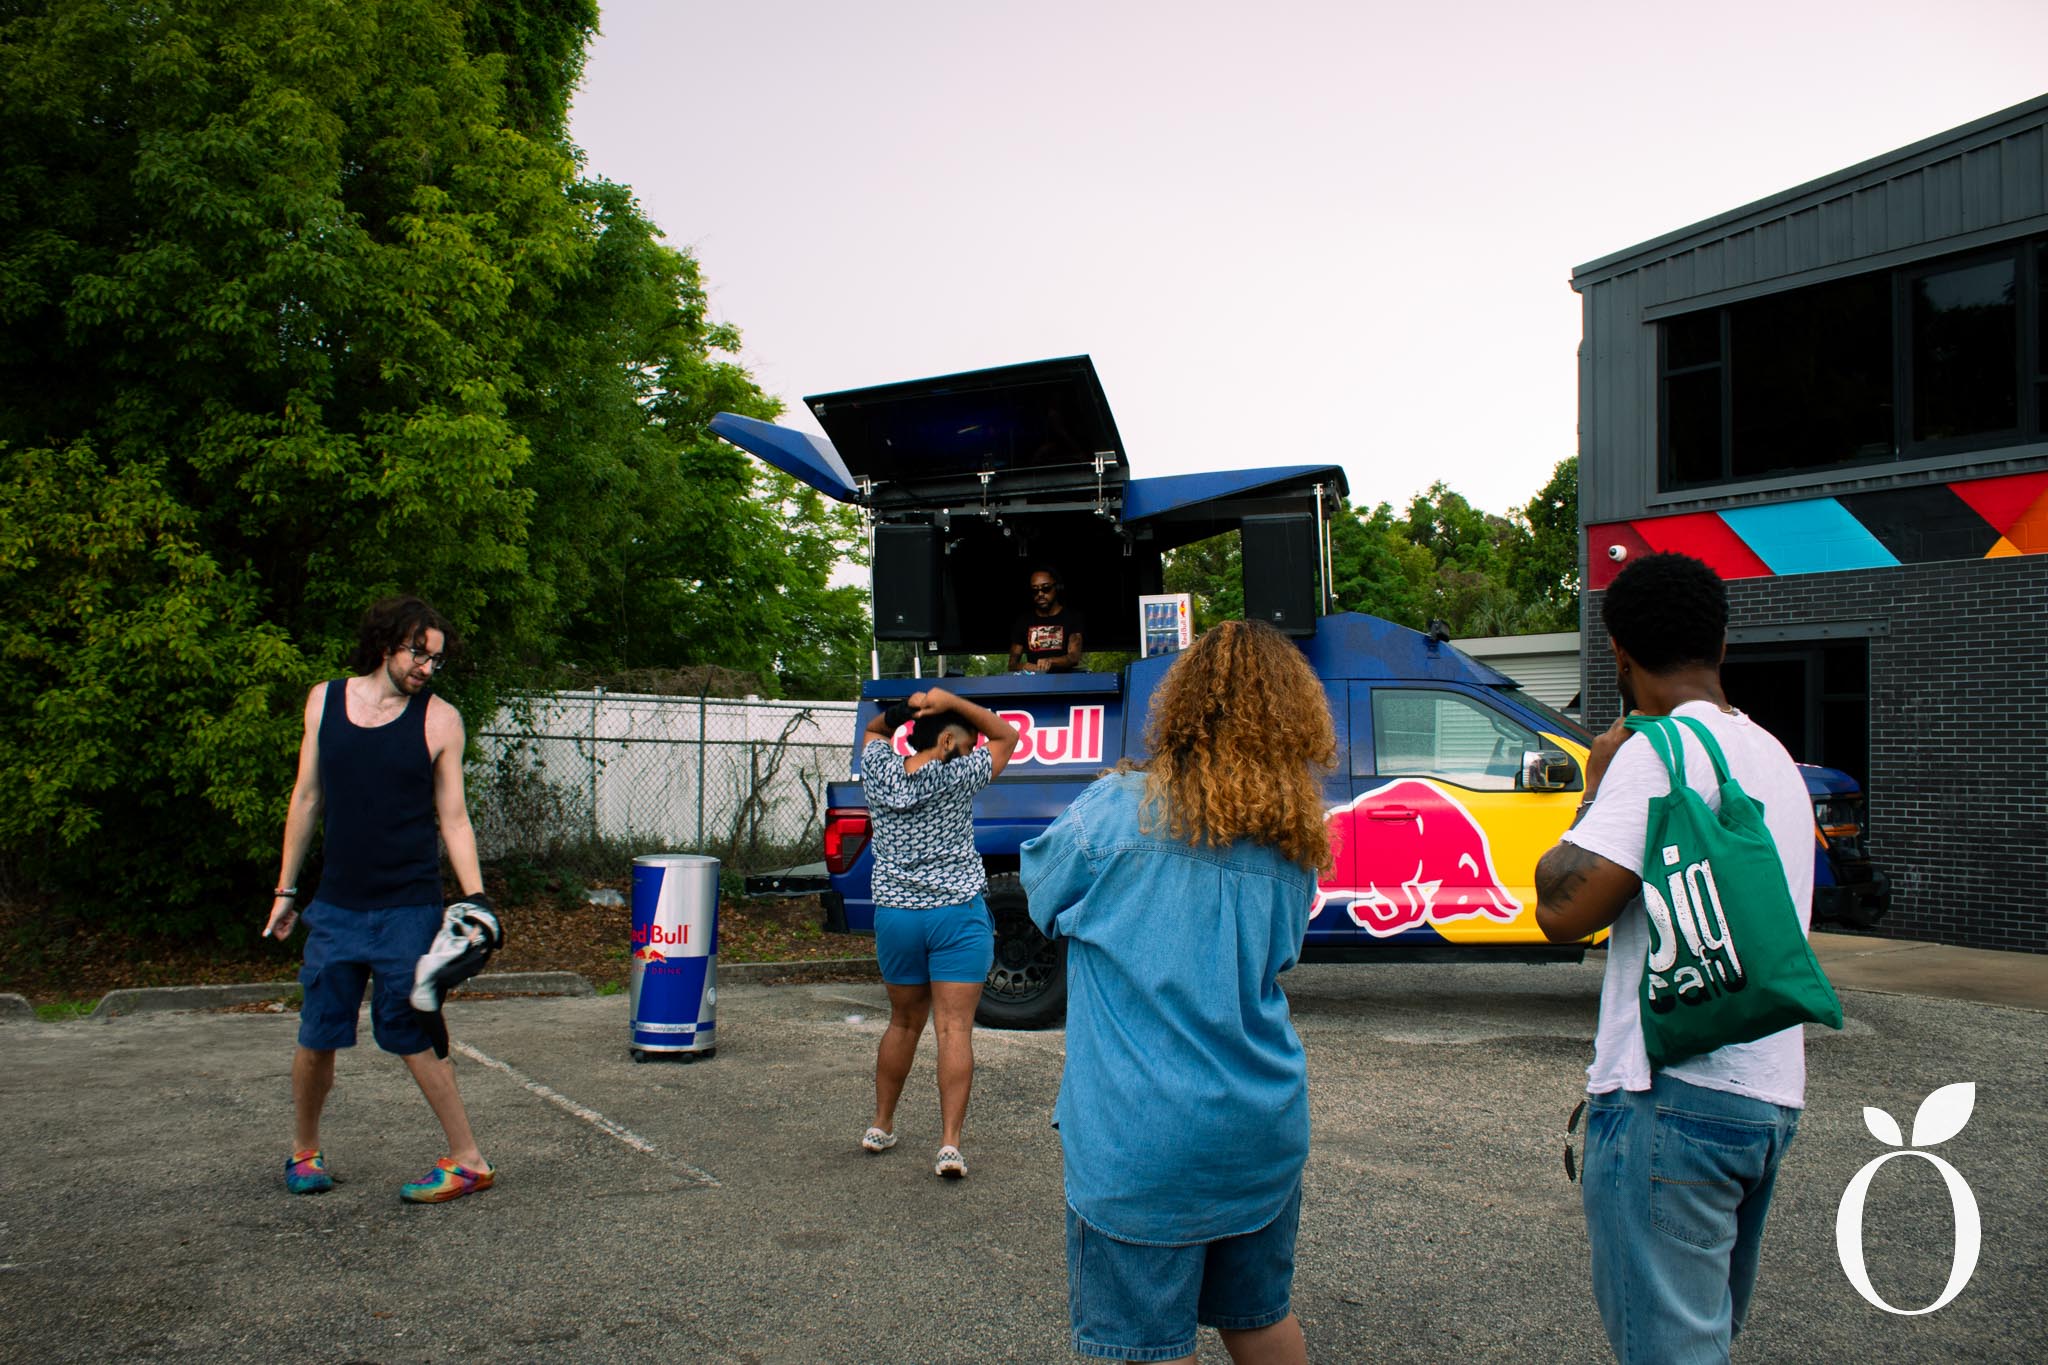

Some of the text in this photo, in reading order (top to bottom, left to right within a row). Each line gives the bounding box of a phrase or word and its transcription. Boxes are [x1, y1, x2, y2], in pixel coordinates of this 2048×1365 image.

[997, 706, 1104, 764] Bull
[631, 923, 688, 944] ed Bull
